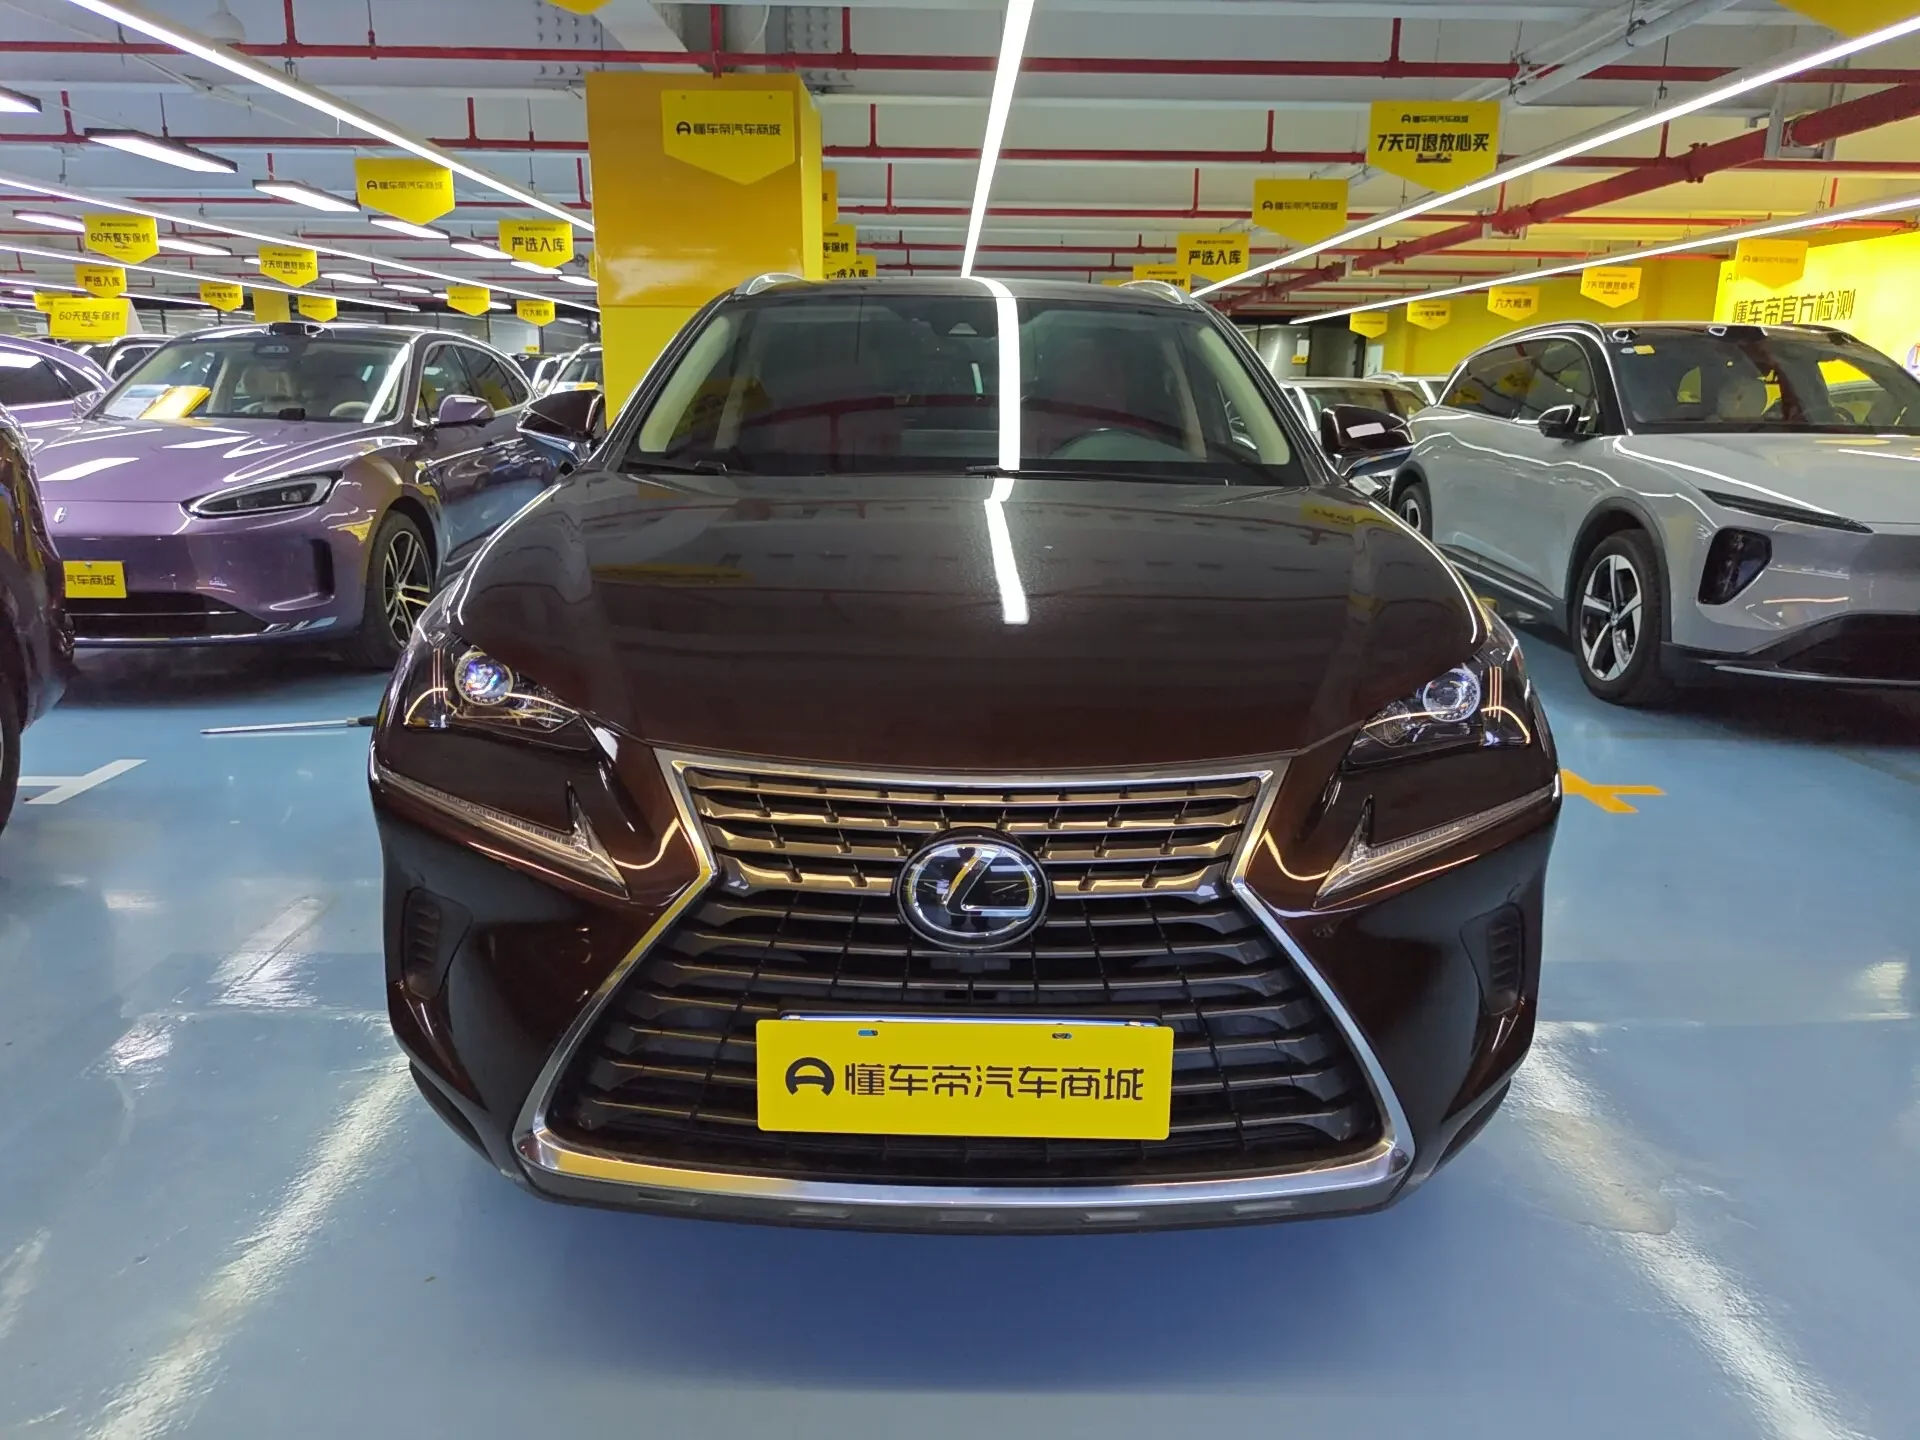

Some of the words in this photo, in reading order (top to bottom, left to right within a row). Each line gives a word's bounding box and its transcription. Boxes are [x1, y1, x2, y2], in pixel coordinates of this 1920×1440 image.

[694, 123, 781, 135] 懂车帝汽车商城
[1377, 133, 1490, 152] 7天可退放心买
[90, 232, 151, 243] 60天整车保修
[512, 236, 566, 252] 严选入库
[1188, 249, 1242, 266] 严选入库
[1732, 289, 1856, 325] 懂车帝官方检测
[58, 310, 120, 321] 60天整车保修
[844, 1062, 1145, 1101] 懂车帝汽车商城
